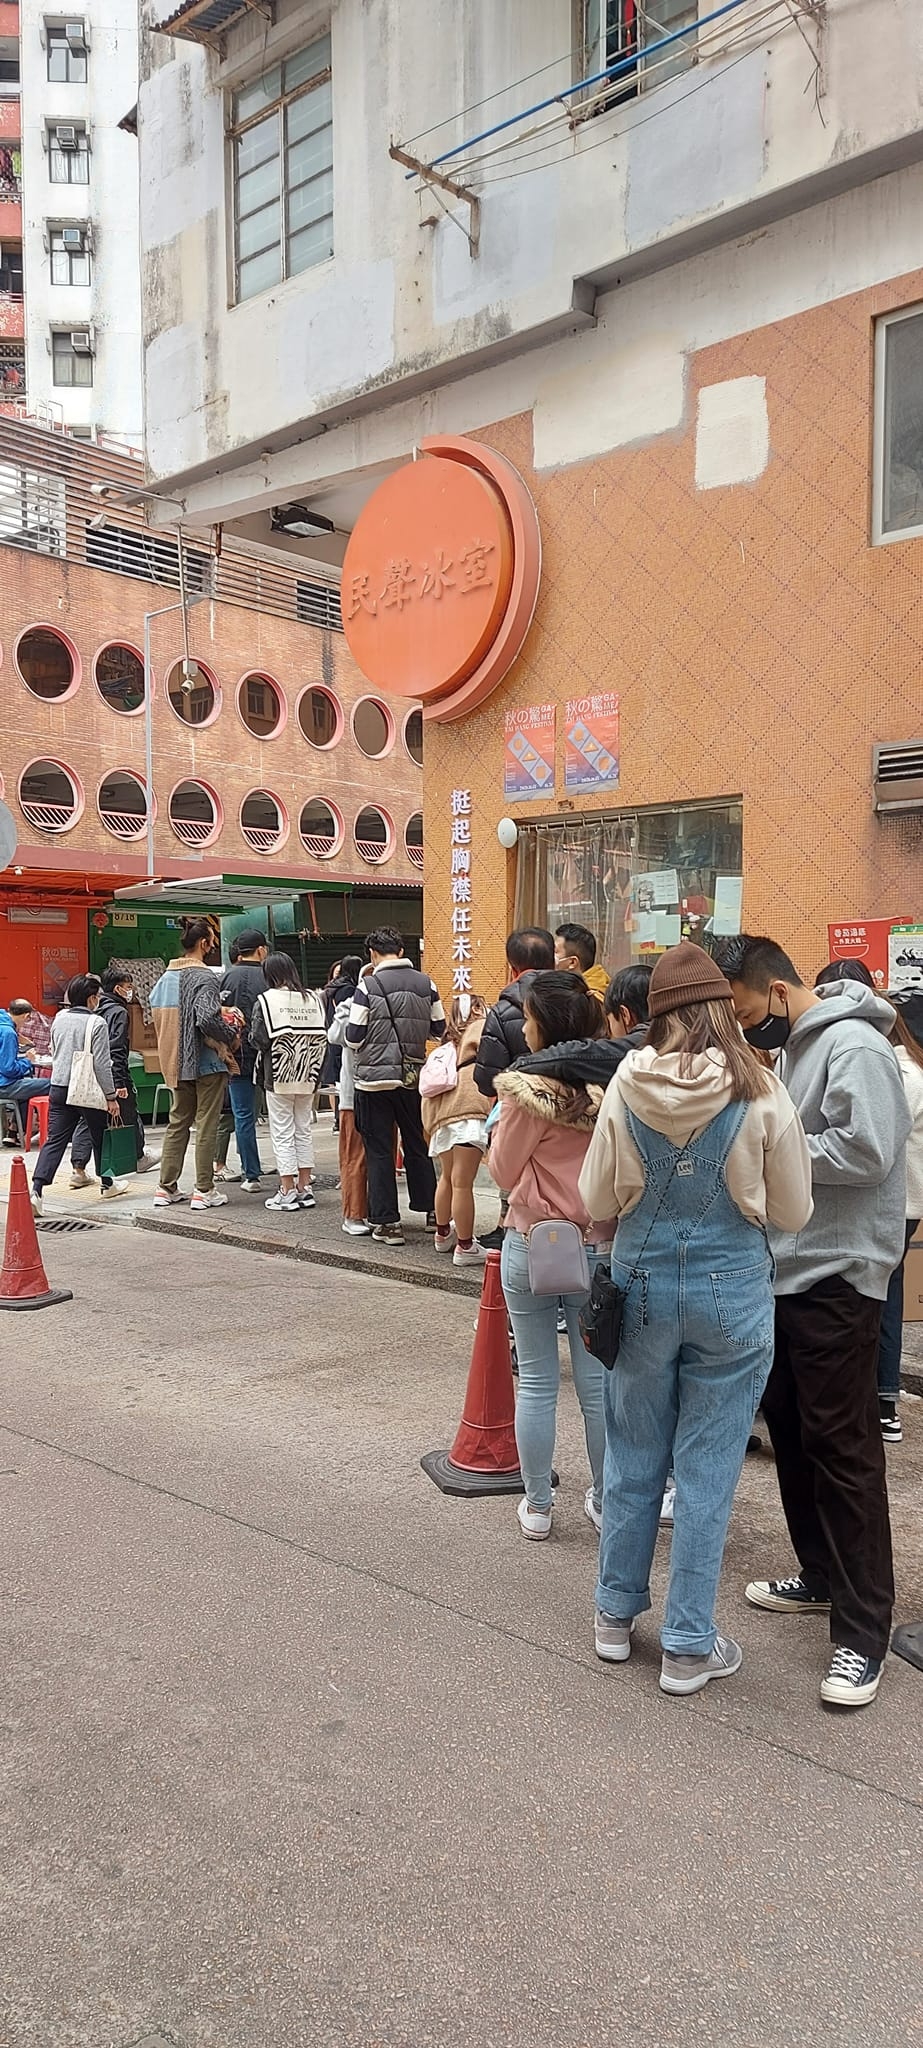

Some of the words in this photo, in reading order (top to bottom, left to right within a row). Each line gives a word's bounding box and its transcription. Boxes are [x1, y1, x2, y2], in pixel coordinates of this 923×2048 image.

[348, 538, 495, 620] 民聲冰室
[450, 789, 473, 1003] 挺起胸襟任未來
